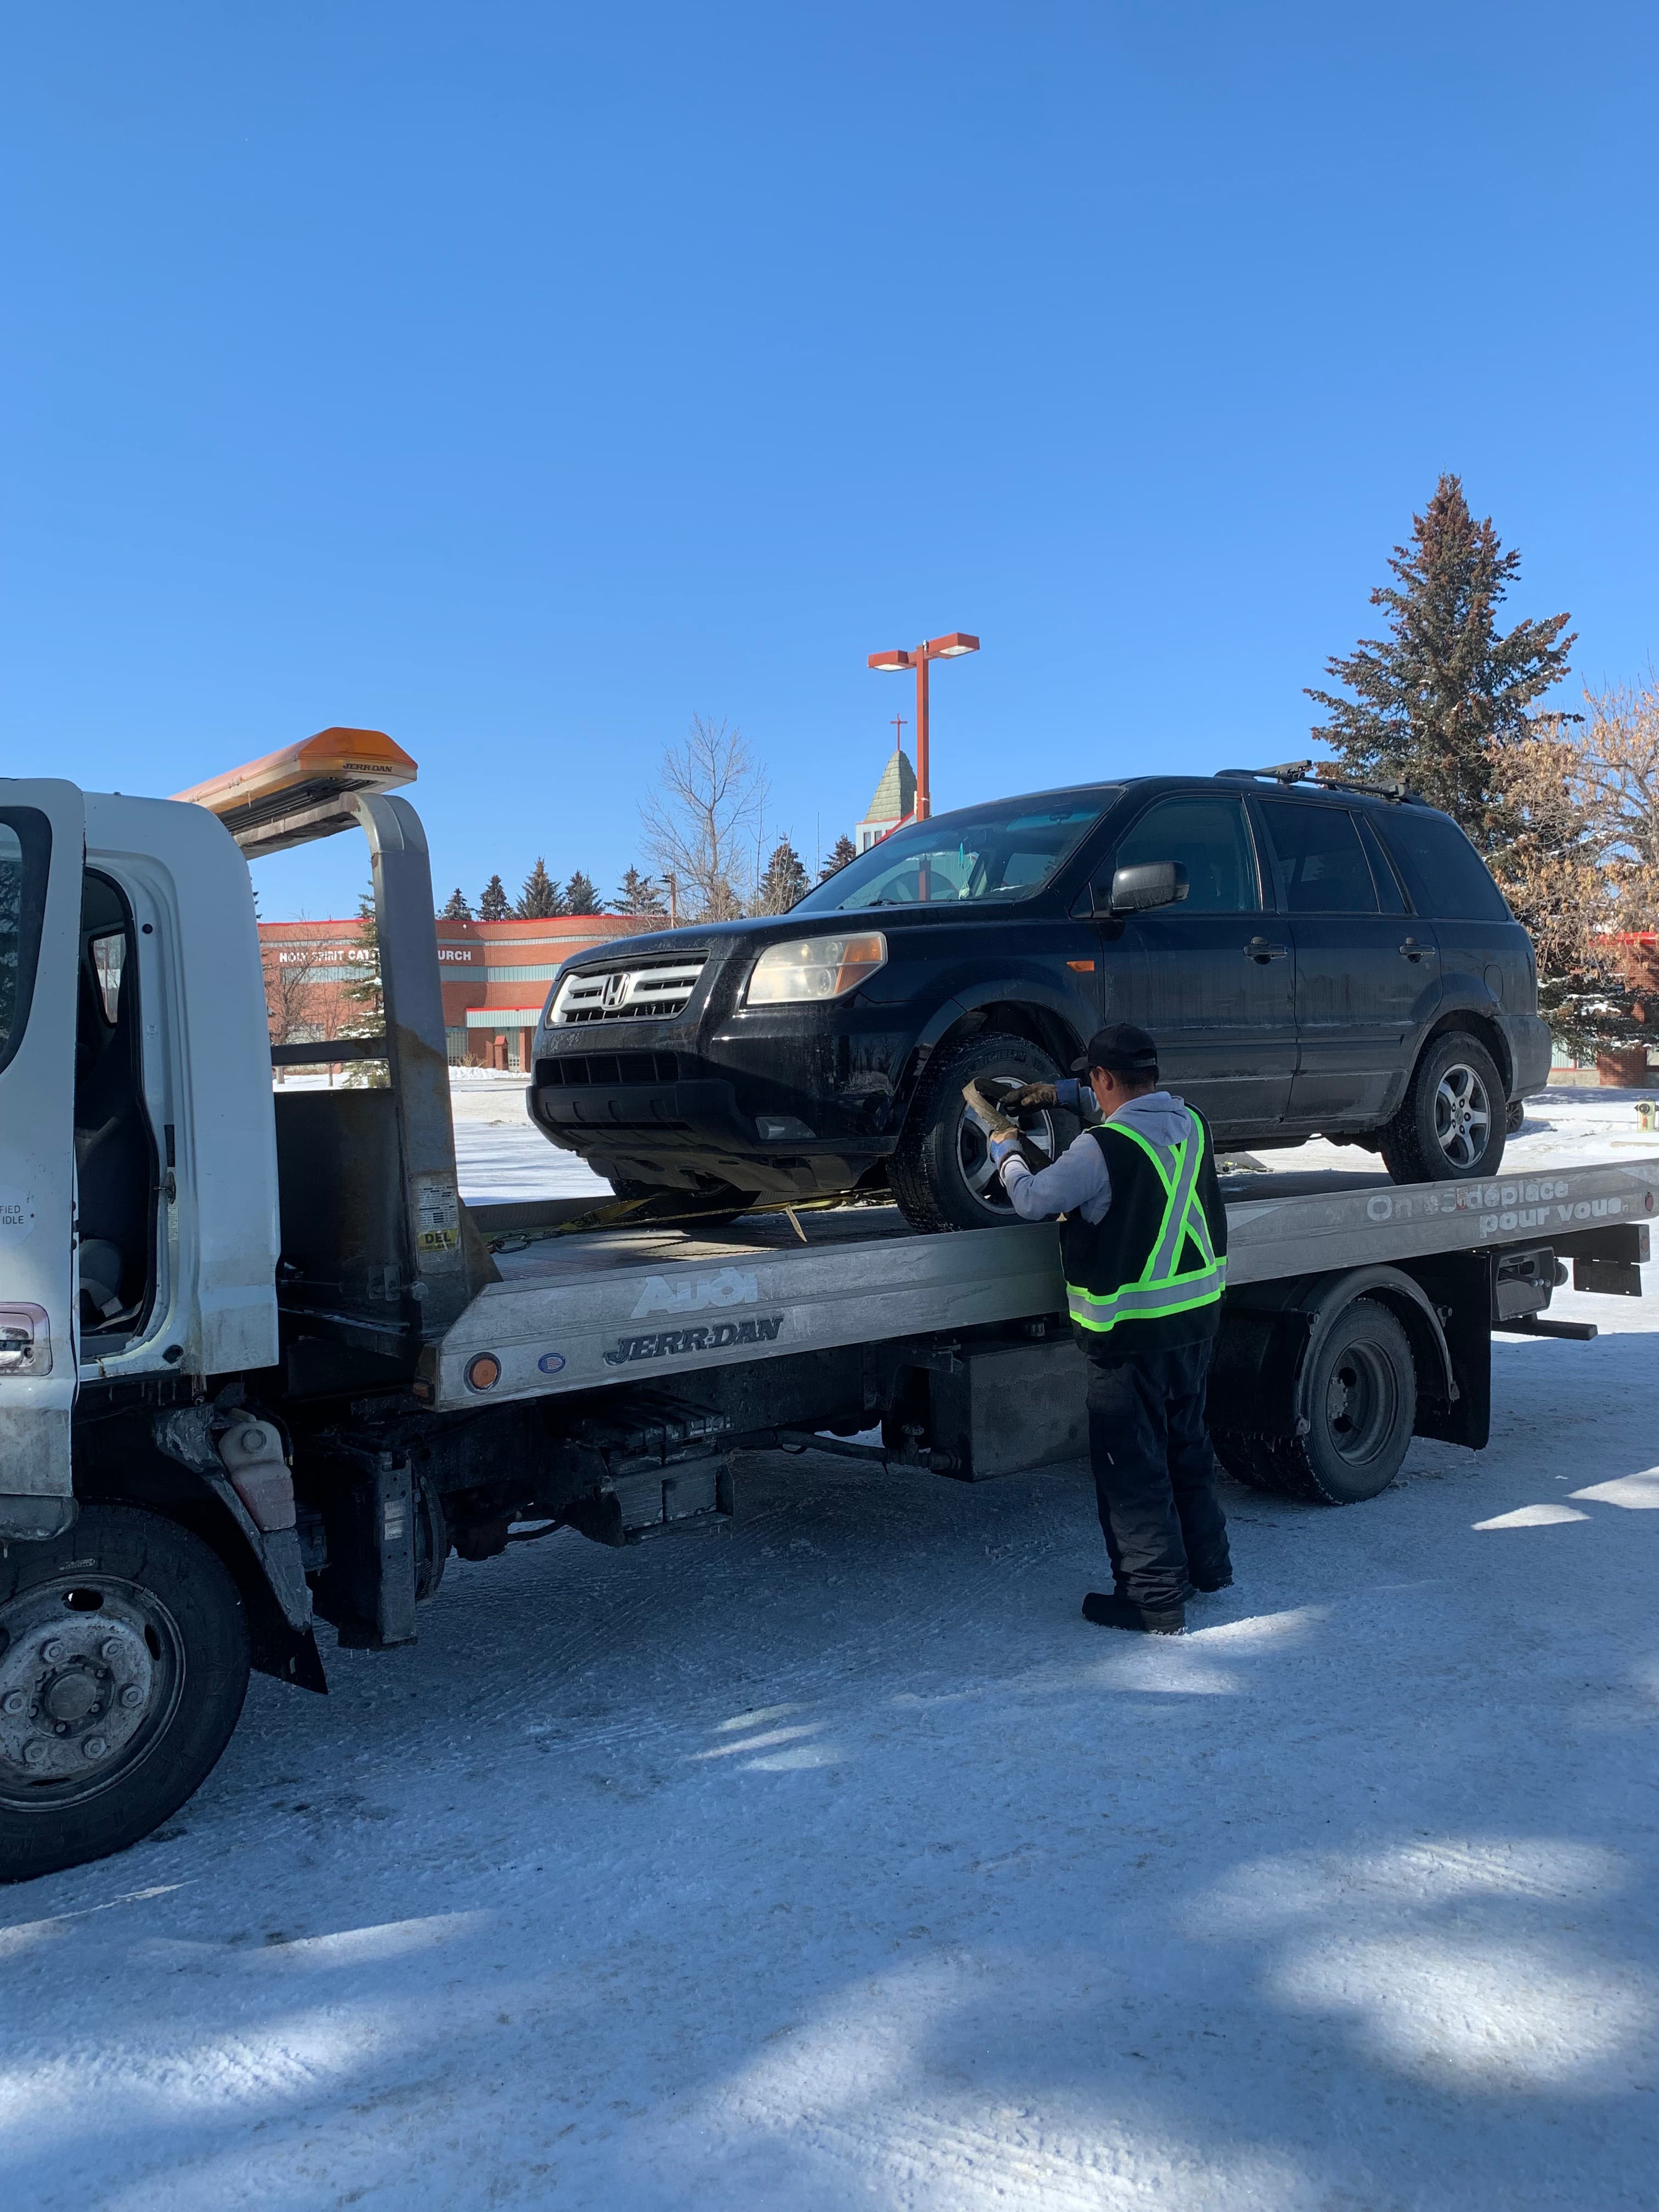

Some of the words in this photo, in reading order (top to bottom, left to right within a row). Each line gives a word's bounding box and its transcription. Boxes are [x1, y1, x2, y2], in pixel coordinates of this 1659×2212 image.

[279, 951, 308, 962] HOLY
[311, 950, 344, 961] SPIRIT
[438, 950, 471, 961] URCH
[0, 1205, 21, 1214] FIED
[2, 1216, 24, 1224] IDLE
[1479, 1207, 1550, 1238] pour
